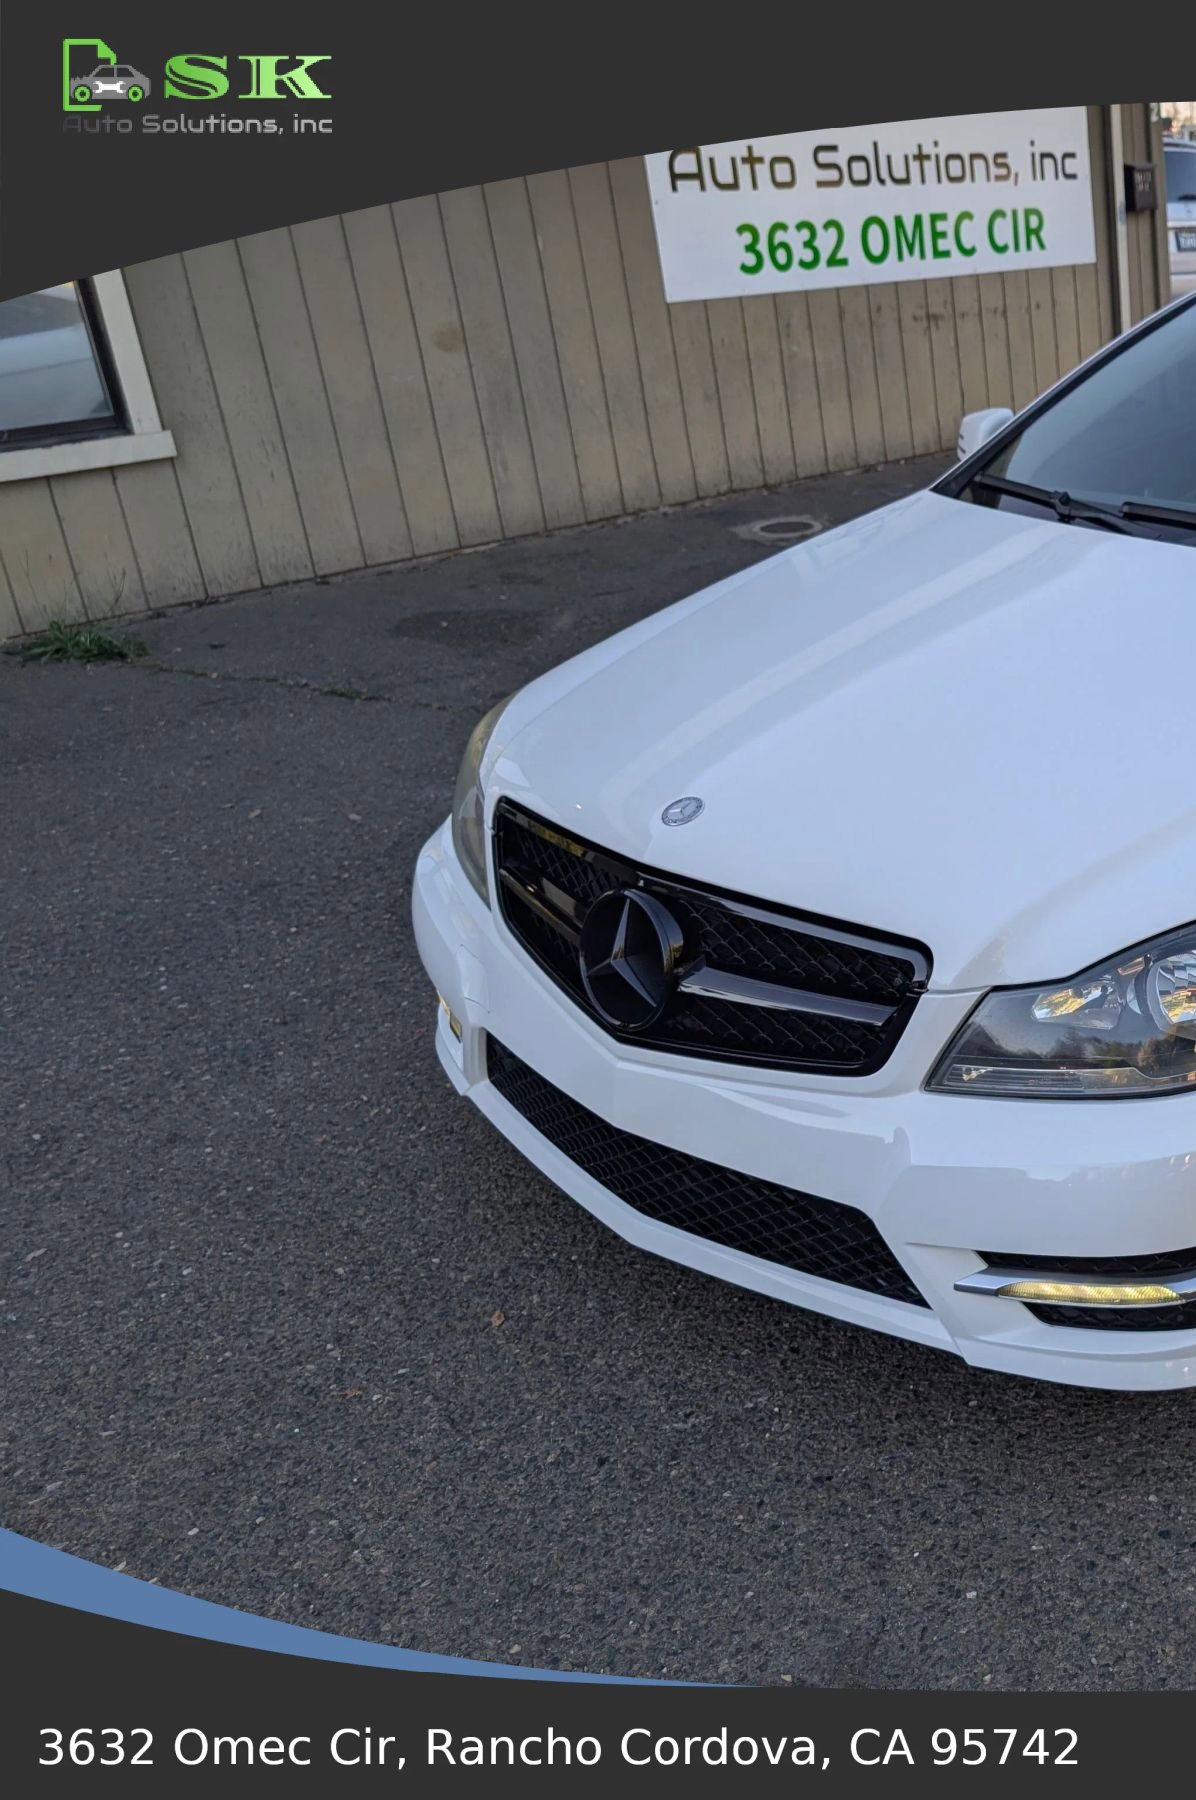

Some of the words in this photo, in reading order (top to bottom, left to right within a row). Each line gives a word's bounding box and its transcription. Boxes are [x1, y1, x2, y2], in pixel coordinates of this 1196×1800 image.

[668, 146, 797, 193] Auto
[812, 139, 1019, 189] Solutions,
[1030, 139, 1078, 181] inc
[735, 218, 849, 276] 3632
[860, 209, 977, 265] OMEC
[987, 207, 1046, 255] CIR
